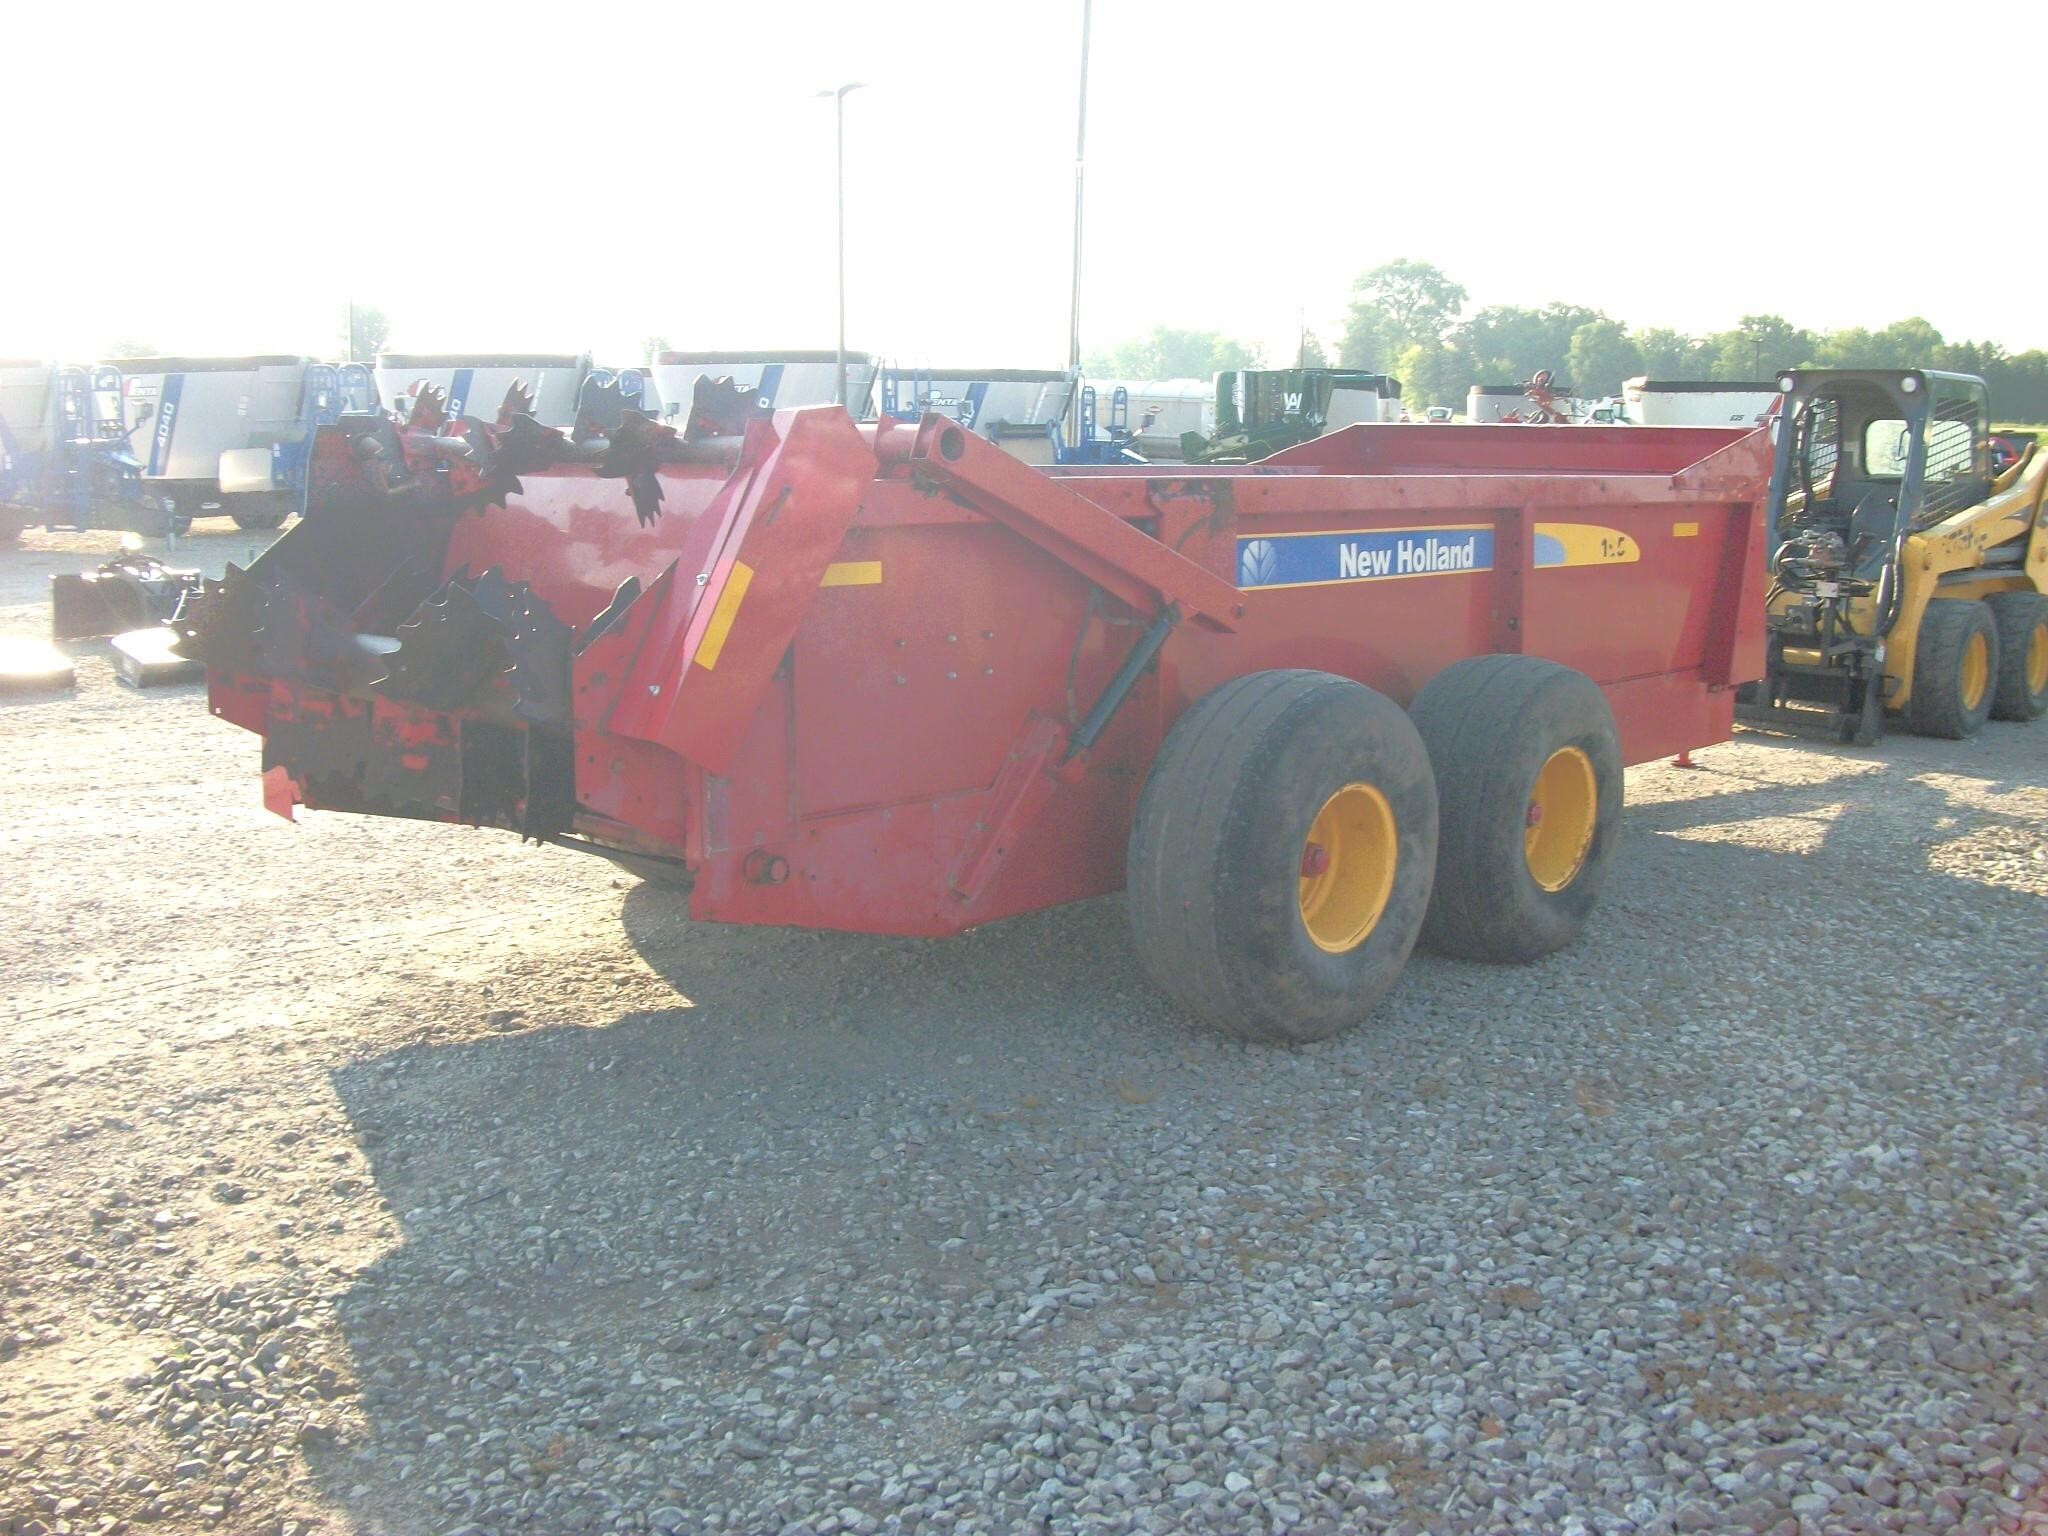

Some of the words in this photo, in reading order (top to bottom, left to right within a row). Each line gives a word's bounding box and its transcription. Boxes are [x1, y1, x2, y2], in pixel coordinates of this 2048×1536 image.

[157, 402, 175, 447] 4040
[1340, 542, 1392, 578] New
[1397, 536, 1475, 573] Holland
